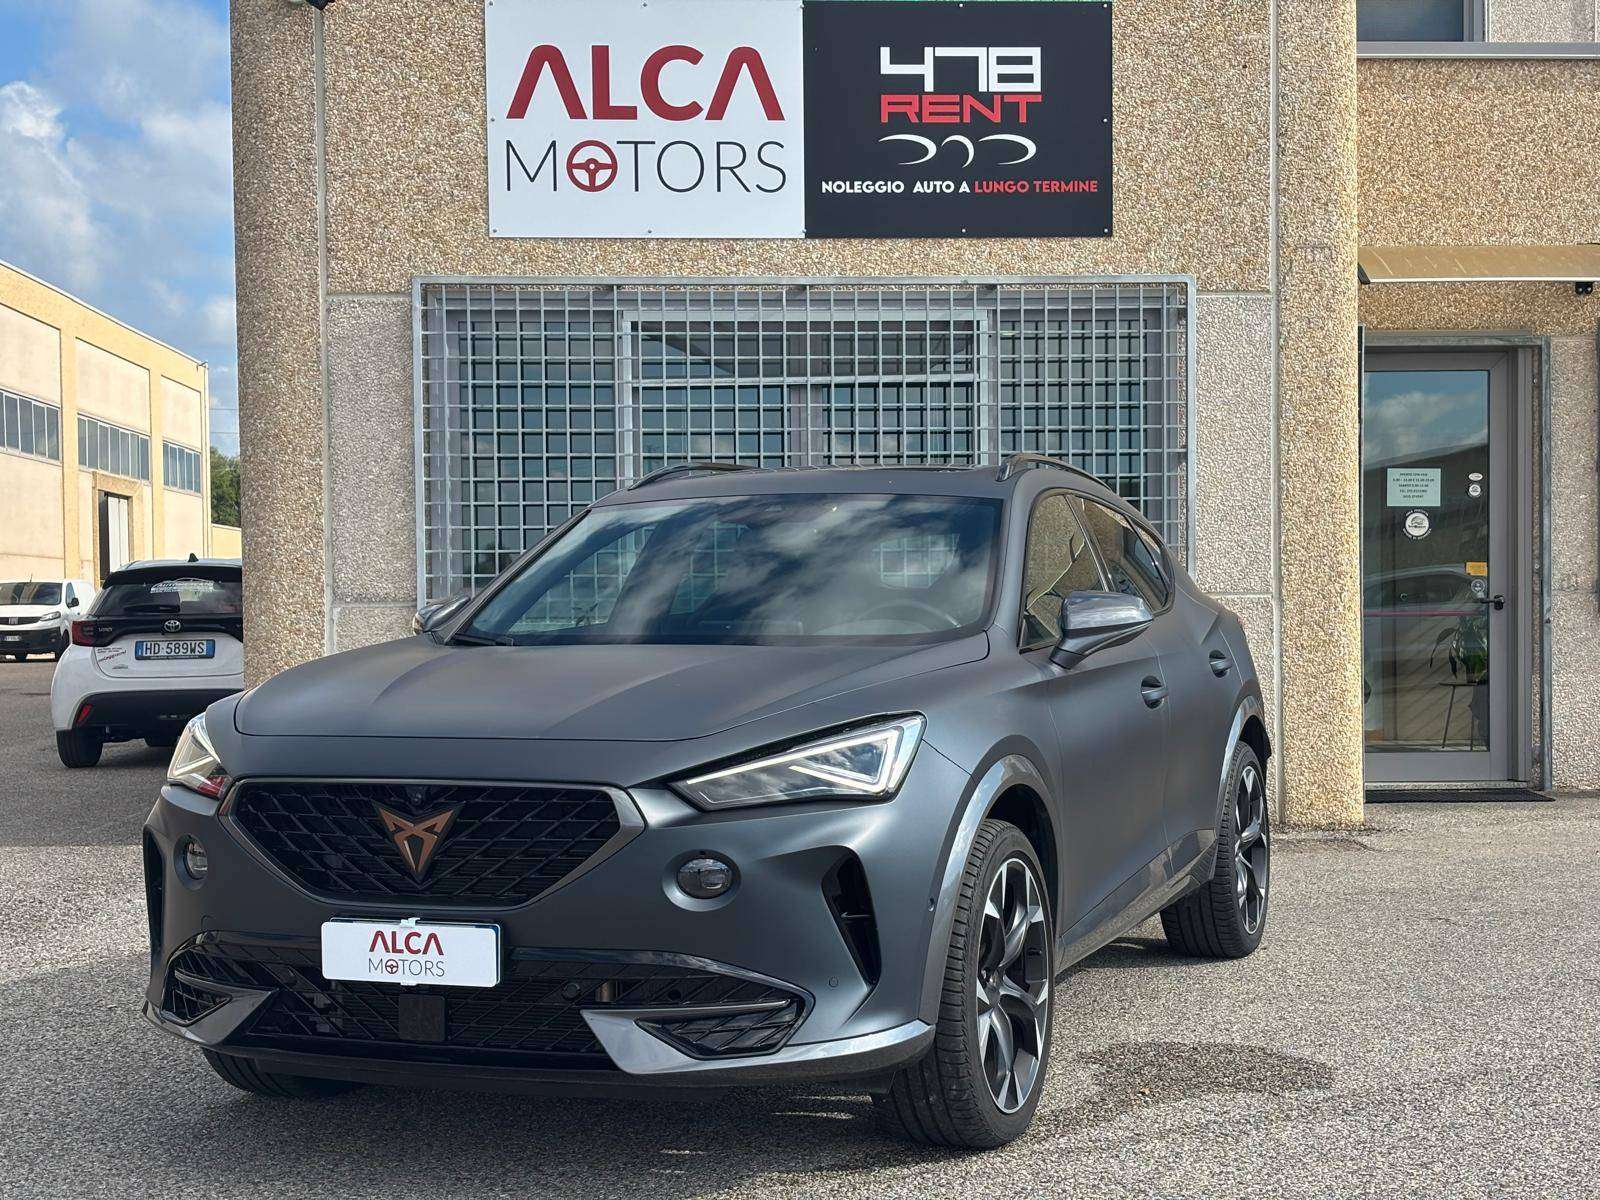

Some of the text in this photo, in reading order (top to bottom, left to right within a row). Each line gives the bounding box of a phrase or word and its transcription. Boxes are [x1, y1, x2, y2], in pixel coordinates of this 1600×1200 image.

[880, 46, 1042, 92] 478
[506, 45, 785, 121] ALCA
[880, 94, 1043, 123] RENT
[506, 140, 786, 193] MOTORS
[821, 180, 1098, 194] NOLEGGIO AUTO A LUNGO TERMINE
[144, 641, 205, 655] HD 589WS
[369, 930, 445, 956] ALCA
[368, 957, 446, 977] MOTORS
